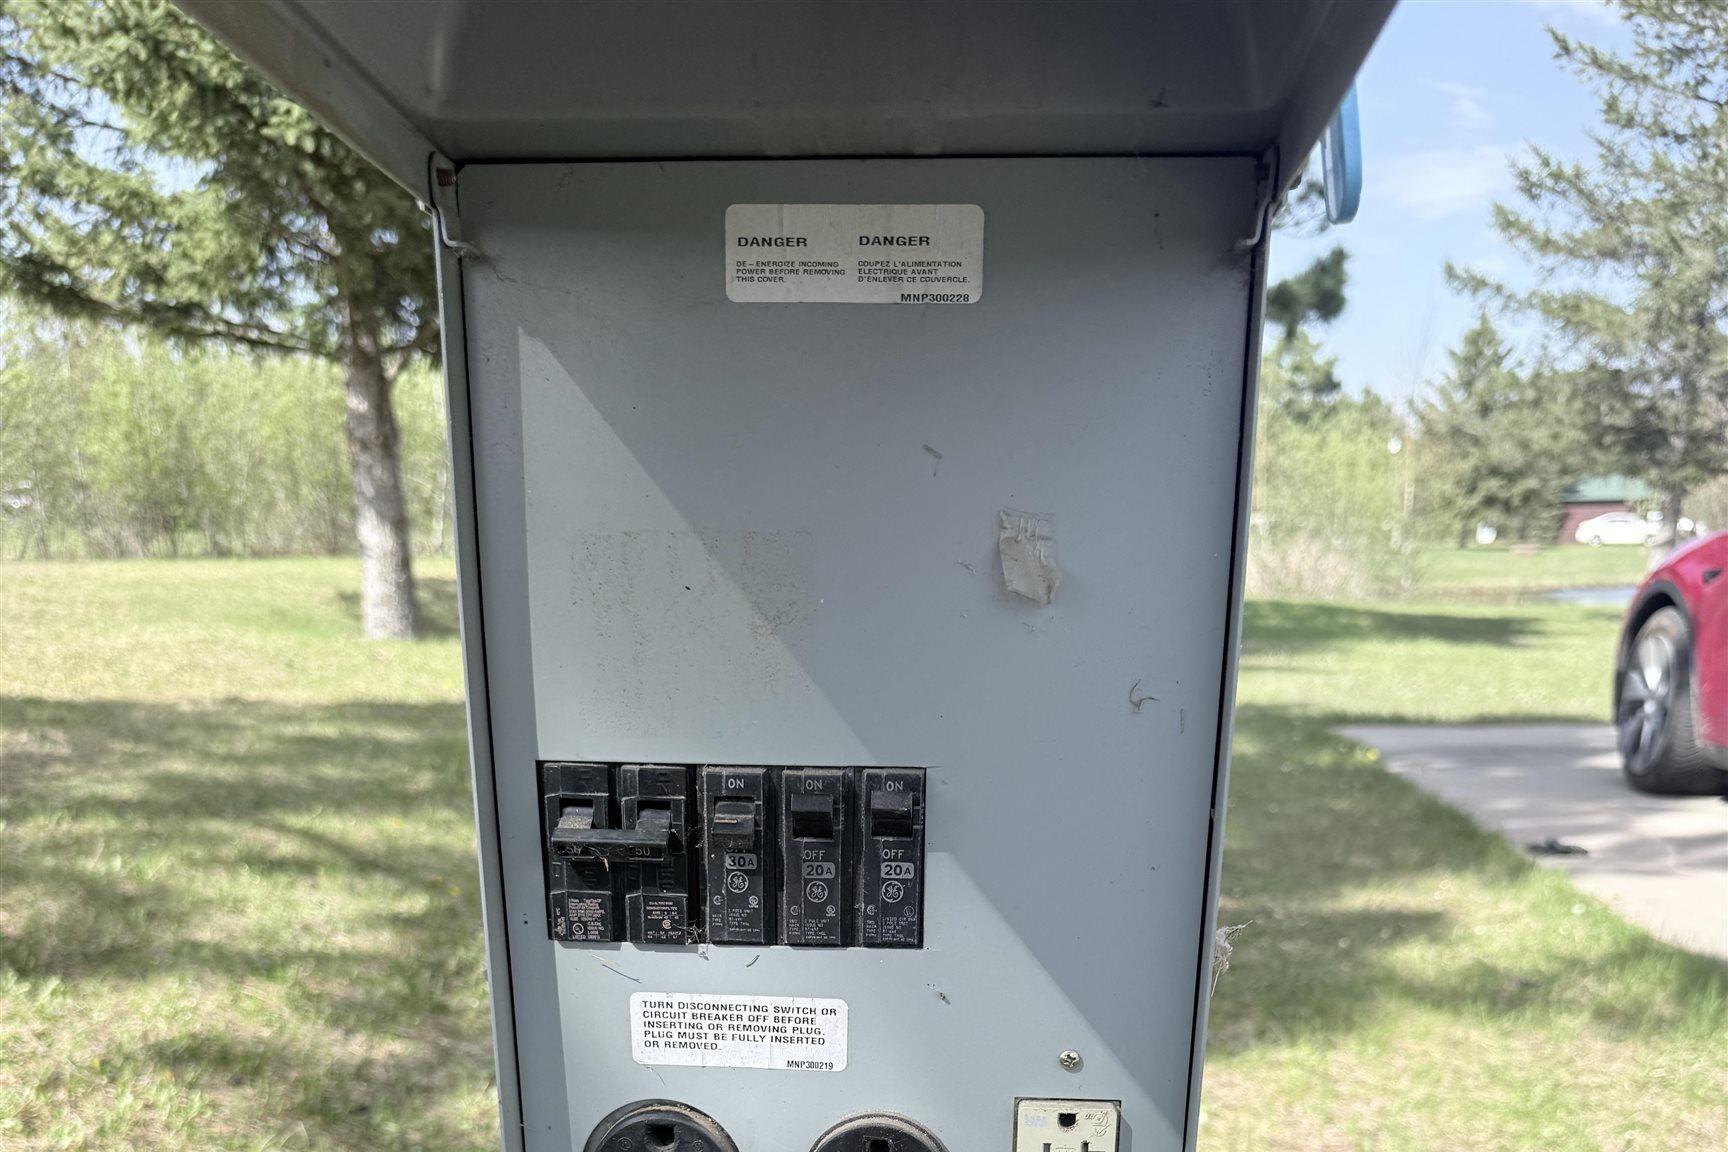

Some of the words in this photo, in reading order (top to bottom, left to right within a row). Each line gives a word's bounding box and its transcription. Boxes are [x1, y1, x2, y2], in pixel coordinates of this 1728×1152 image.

[737, 236, 808, 248] DANGER
[859, 235, 931, 247] DANGER
[736, 268, 766, 276] POWER
[768, 268, 800, 276] BEFORE
[900, 293, 970, 303] MNP300228
[728, 778, 744, 789] ON
[805, 779, 823, 790] ON
[886, 781, 903, 792] ON
[635, 846, 651, 856] 50
[804, 850, 826, 860] OFF
[882, 849, 905, 860] OFF
[728, 856, 755, 868] 30A
[806, 865, 833, 876] 20A
[884, 864, 912, 876] 20A
[642, 1000, 673, 1009] TURN
[678, 1001, 769, 1013] DISCONNECTING
[773, 1005, 817, 1015] SWITCH
[821, 1008, 837, 1016] OR
[642, 1011, 687, 1019] CIRCUIT
[692, 1012, 743, 1022] BREAKER
[748, 1014, 769, 1023] OFF
[773, 1016, 817, 1025] BEFORE
[643, 1021, 703, 1030] INSERTING
[707, 1022, 723, 1031] OR
[728, 1023, 787, 1034] REMOVING
[792, 1026, 825, 1036] PLUG.
[644, 1030, 673, 1039] PLUG
[677, 1031, 708, 1040] MUST
[713, 1033, 728, 1041] BE
[732, 1034, 766, 1043] FULLY
[770, 1035, 826, 1046] INSERTED
[644, 1040, 660, 1048] OR
[786, 1060, 834, 1070] MNP300219
